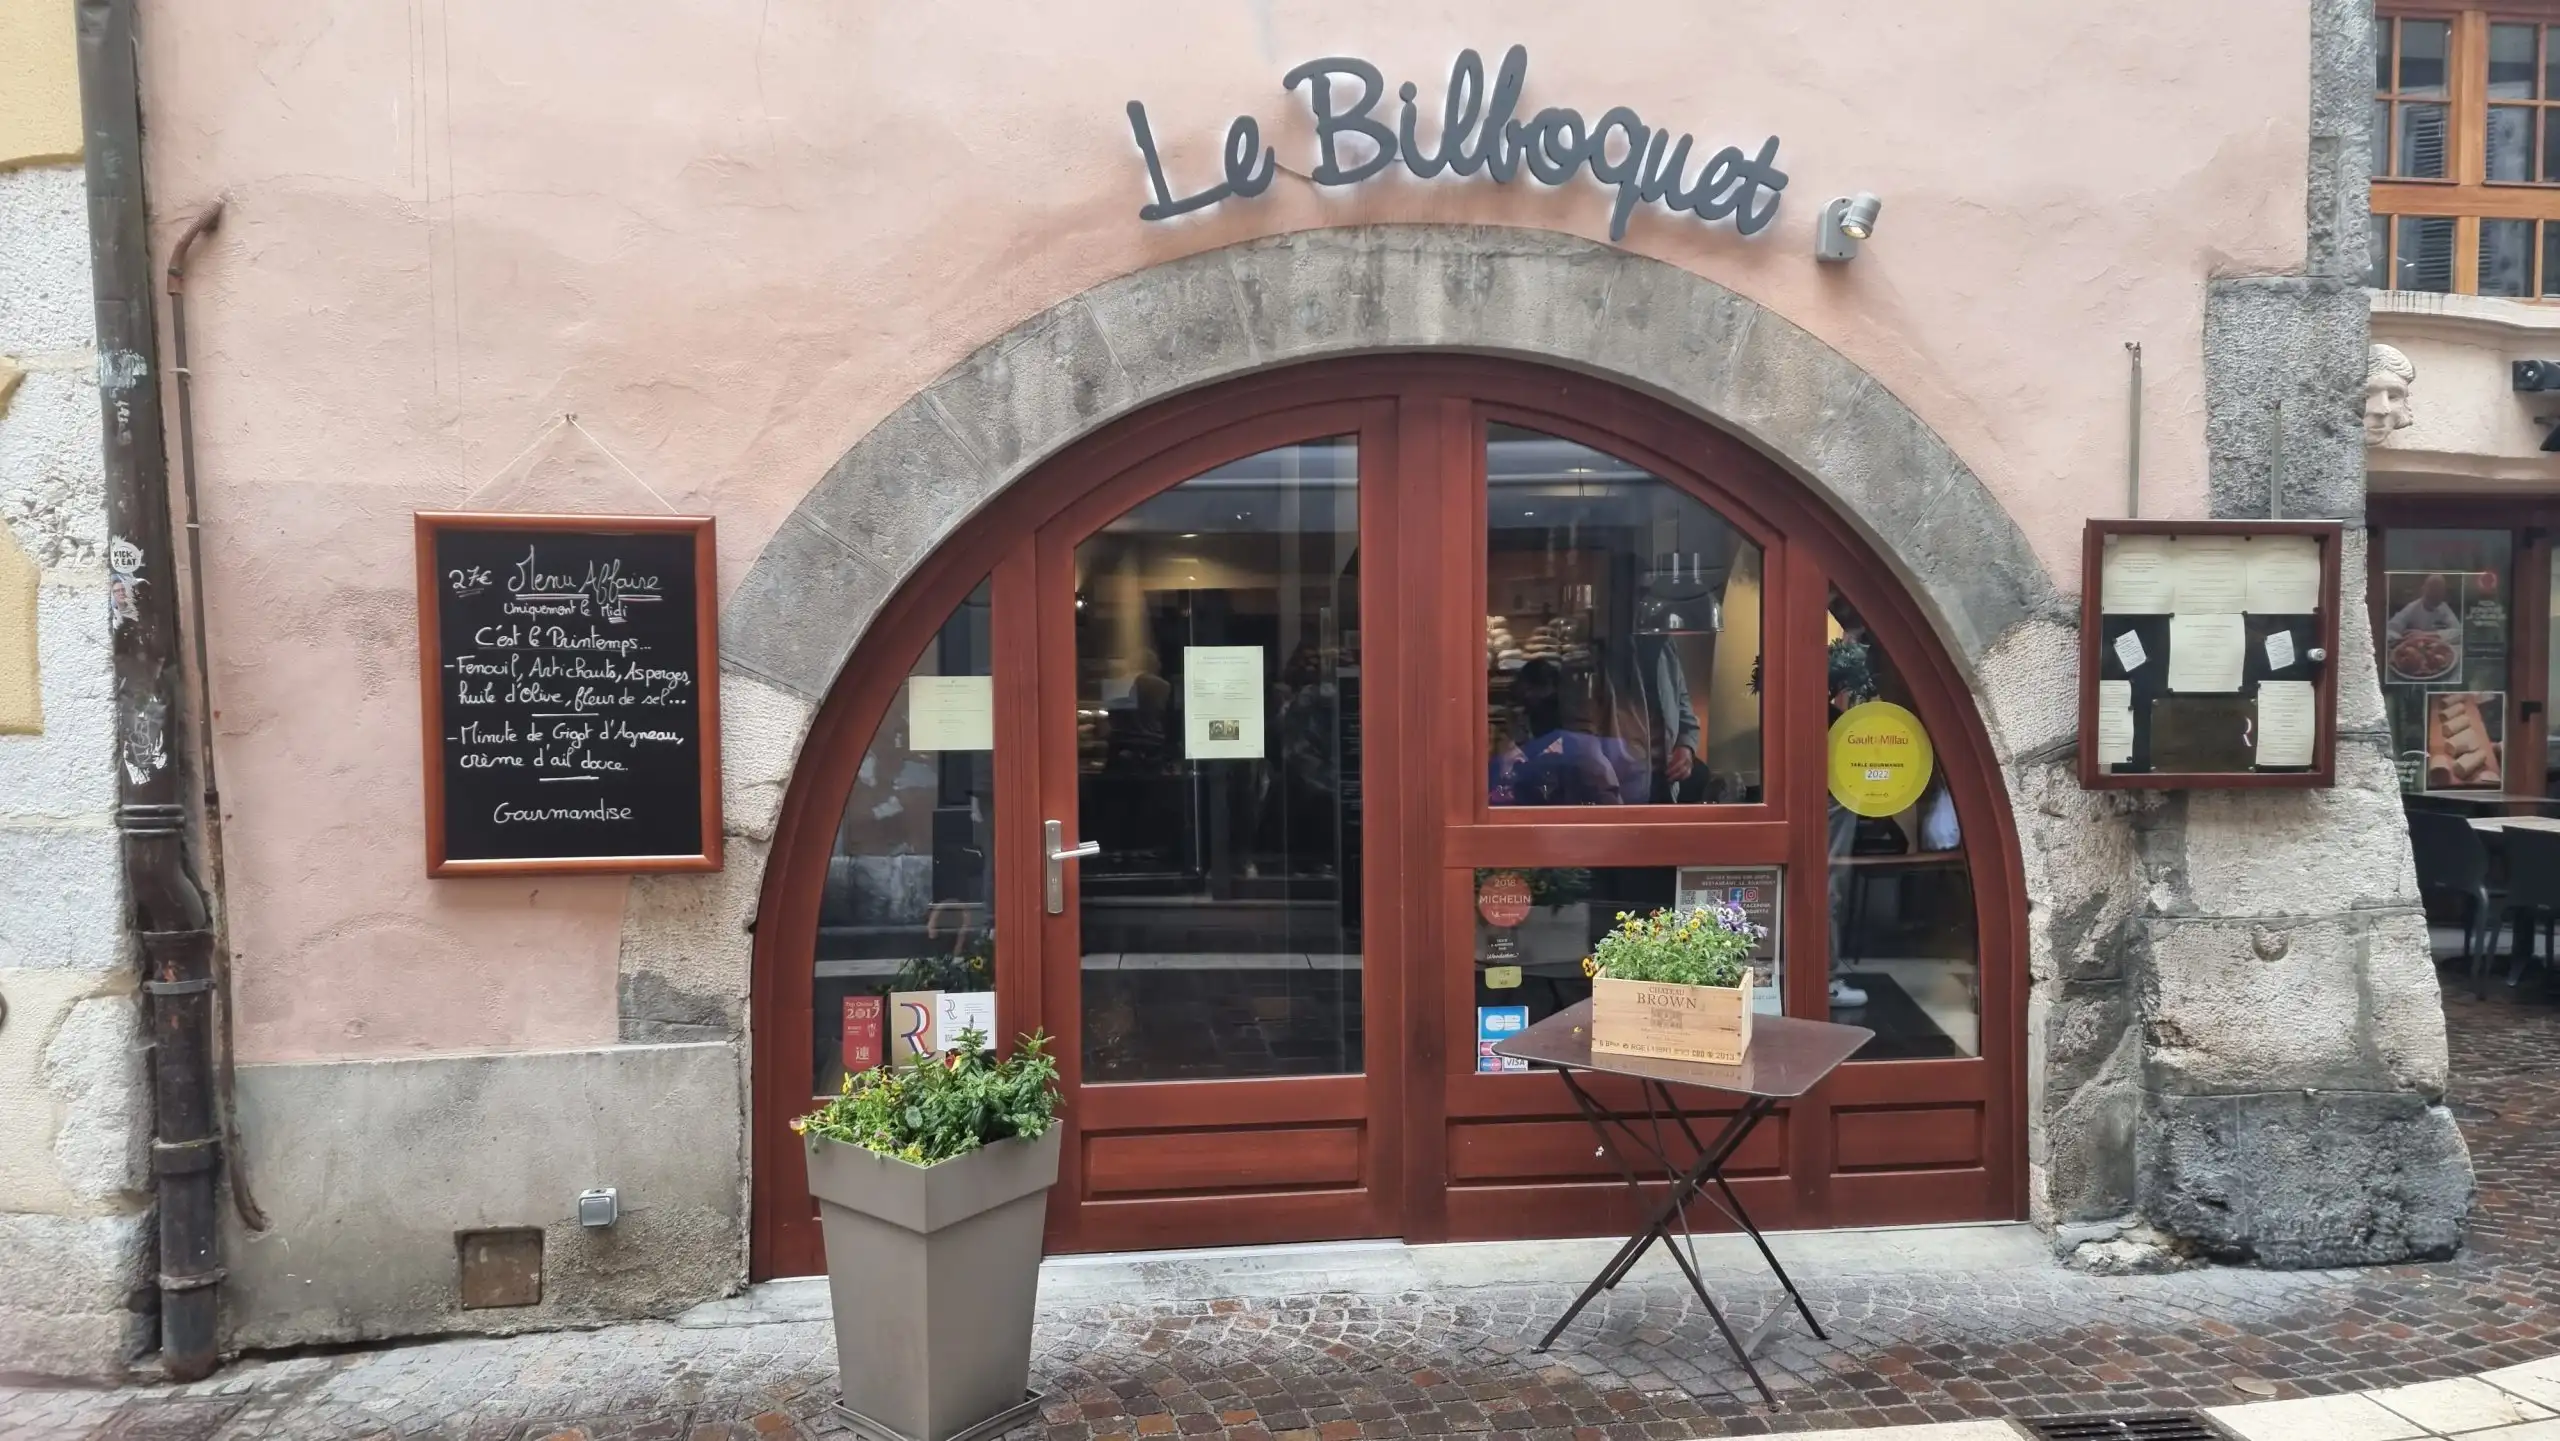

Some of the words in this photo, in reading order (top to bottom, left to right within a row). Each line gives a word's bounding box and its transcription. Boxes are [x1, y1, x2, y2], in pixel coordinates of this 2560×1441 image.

[1127, 99, 1274, 222] Le
[1283, 44, 1789, 242] Bilboquet
[448, 565, 493, 589] 27€
[508, 544, 576, 592] Menu
[578, 558, 663, 604] Affaire
[503, 601, 576, 622] Uniquement
[580, 600, 592, 617] le
[601, 602, 628, 617] Midi
[475, 625, 522, 646] C'est
[529, 626, 541, 647] le
[459, 680, 496, 705] huile
[575, 686, 615, 711] fleur
[618, 687, 635, 705] de
[527, 722, 543, 741] de
[552, 722, 593, 749] Gigot
[460, 753, 524, 768] crème
[1867, 769, 1889, 779] 2022
[493, 798, 635, 823] Gourmandise
[1480, 894, 1531, 904] MICHELIN
[1637, 992, 1697, 1009] BROWN
[1506, 1058, 1526, 1067] VISA
[1715, 1051, 1736, 1061] 2013
